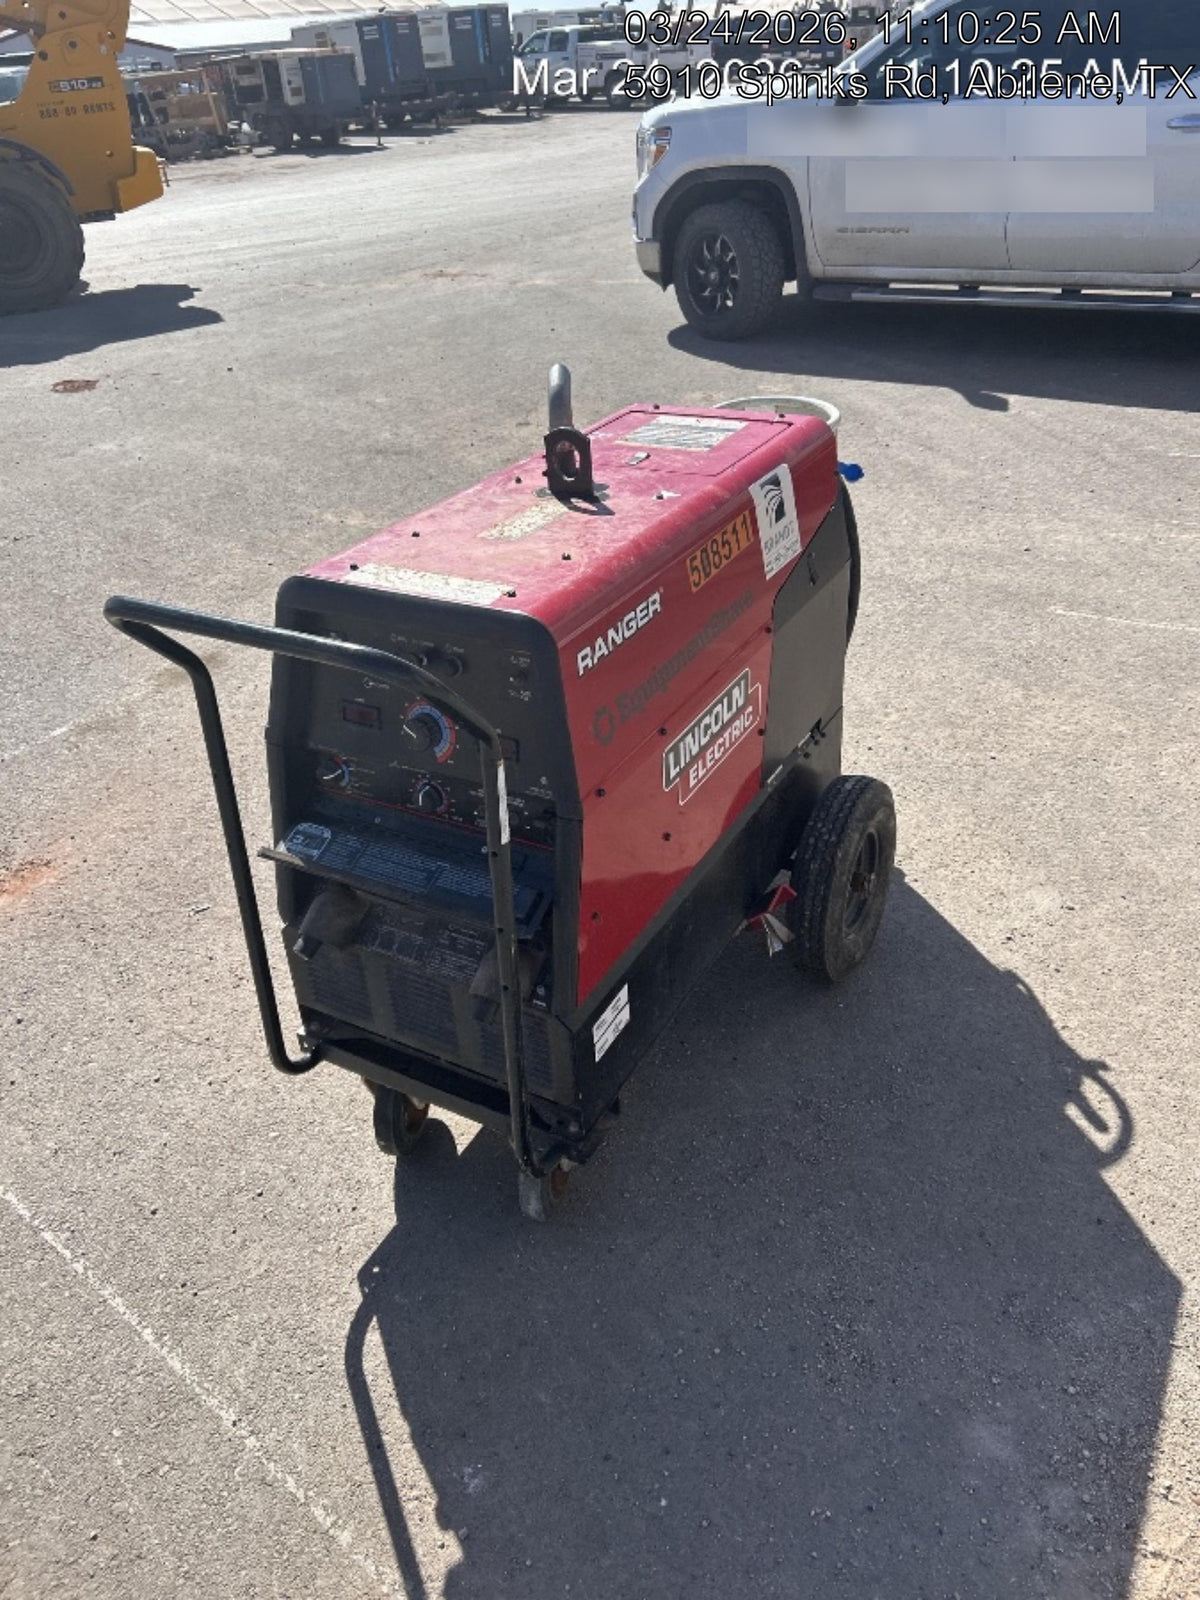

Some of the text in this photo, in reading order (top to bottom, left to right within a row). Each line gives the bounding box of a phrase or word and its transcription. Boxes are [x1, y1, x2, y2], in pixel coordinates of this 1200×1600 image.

[688, 512, 752, 588] 508511
[576, 590, 661, 677] RANGER
[667, 679, 746, 780] LINCOLN
[688, 705, 753, 788] ELECTRIC
